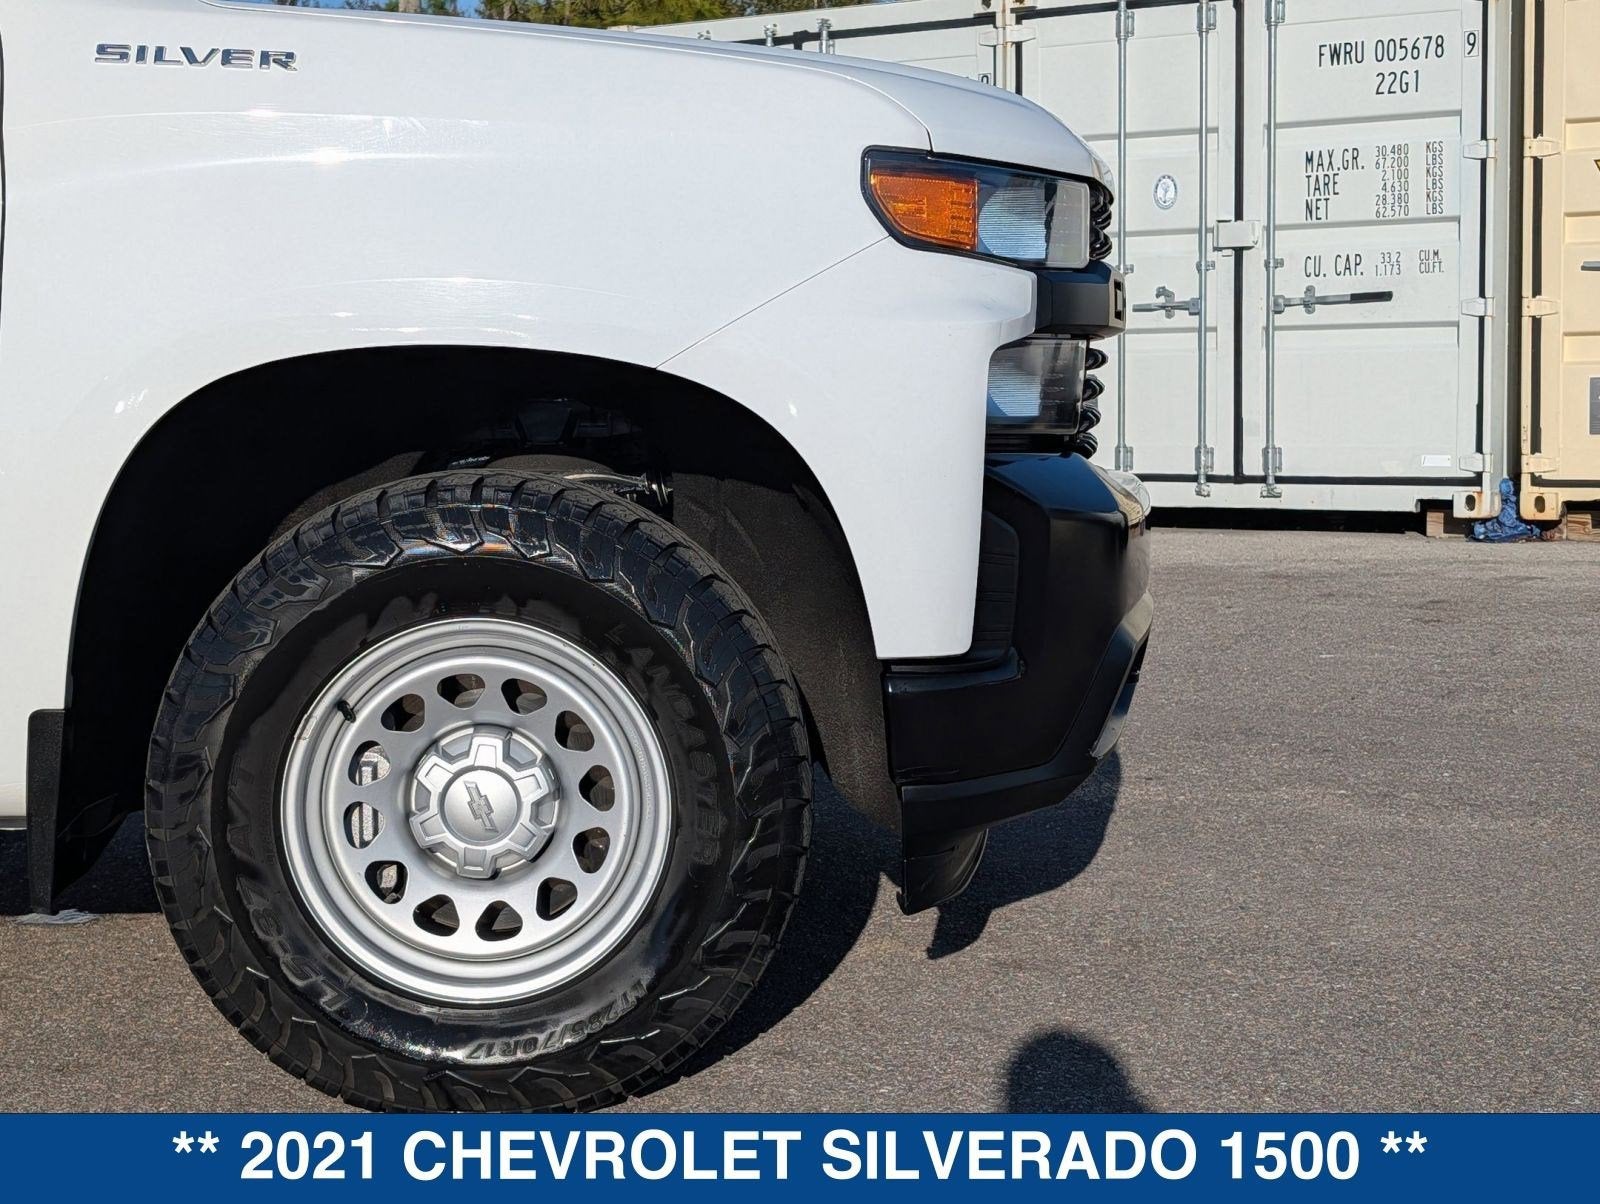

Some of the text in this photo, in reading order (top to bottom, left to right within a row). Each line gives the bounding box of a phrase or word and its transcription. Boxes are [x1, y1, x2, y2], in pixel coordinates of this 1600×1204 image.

[95, 43, 298, 72] SILVER
[1318, 32, 1477, 67] FWRU 005678 9
[1375, 69, 1420, 95] 22G1
[1305, 147, 1365, 173] MAX.GR.
[1426, 141, 1444, 153] KGS
[1375, 154, 1444, 170] 67.200 LBS
[1305, 166, 1444, 197] TARE 2.100 KGS
[1381, 178, 1444, 194] 4.630 LBS
[1305, 198, 1330, 221] NET
[1426, 190, 1444, 203] KGS
[1375, 202, 1444, 218] 62.570 LBS
[1304, 256, 1327, 278] CU.
[1334, 253, 1364, 276] CAP.
[1380, 251, 1401, 264] 33.2
[1375, 264, 1401, 277] 1.173
